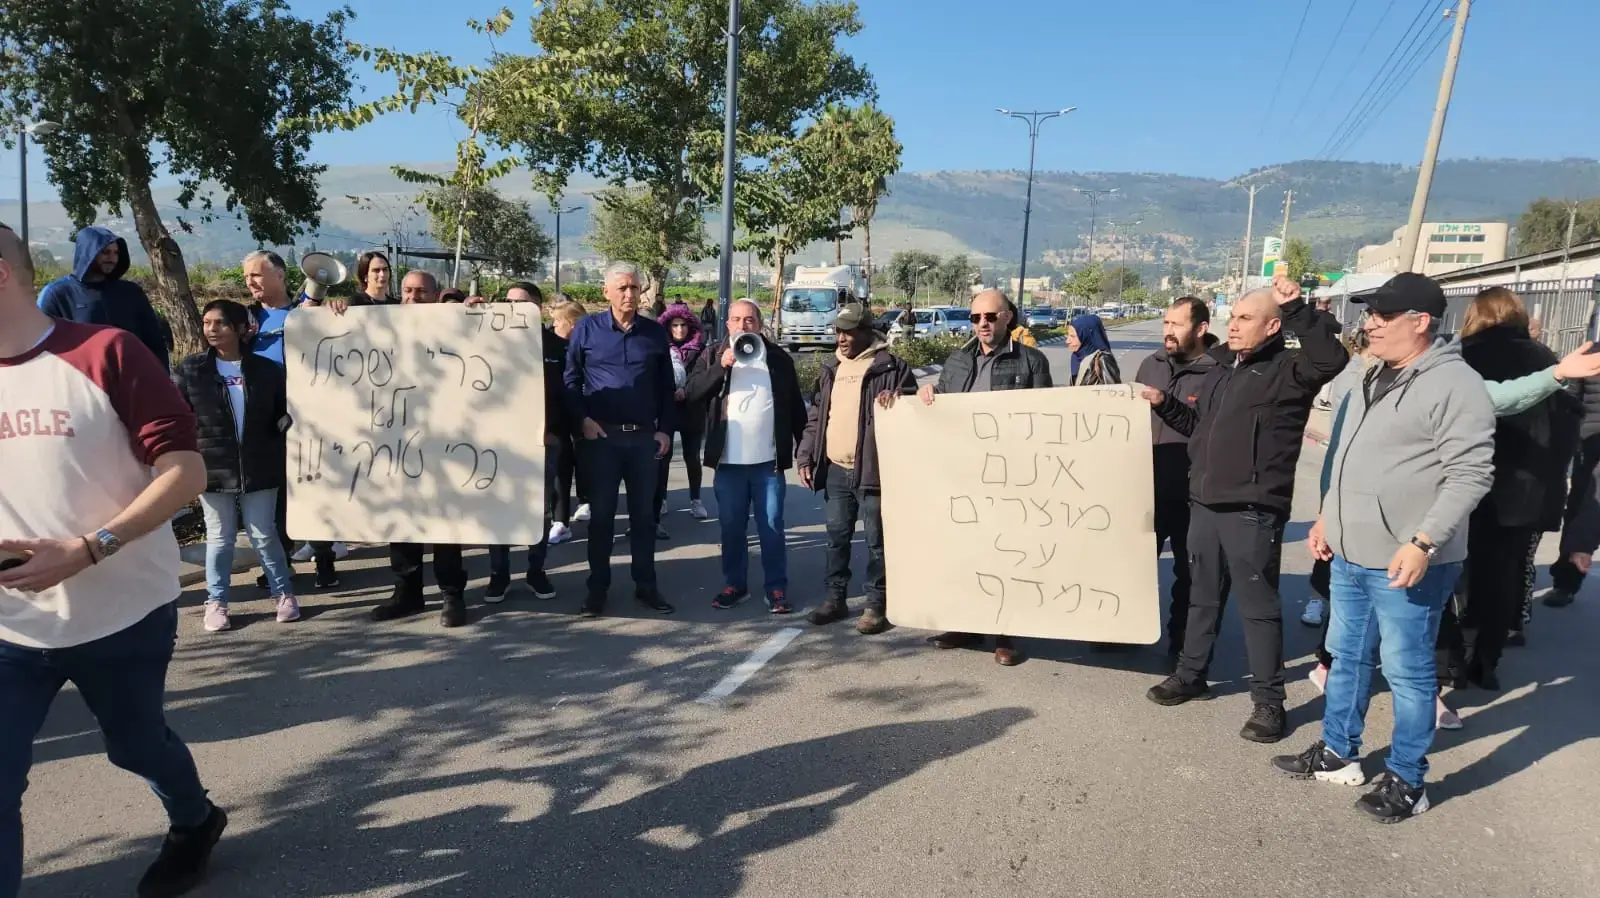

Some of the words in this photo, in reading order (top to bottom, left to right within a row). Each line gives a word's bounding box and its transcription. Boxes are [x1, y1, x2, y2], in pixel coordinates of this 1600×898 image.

[1438, 224, 1460, 232] אלון
[1463, 224, 1481, 232] בית
[301, 331, 394, 387] ישראלי
[427, 348, 493, 391] פרי
[0, 409, 75, 439] AGLE
[370, 385, 416, 431] ולא
[972, 412, 1130, 444] העובדים
[445, 443, 497, 489] פרי
[981, 452, 1084, 490] אינם
[950, 495, 1111, 531] מוצרים
[993, 533, 1057, 568] על
[975, 571, 1120, 624] המדף
